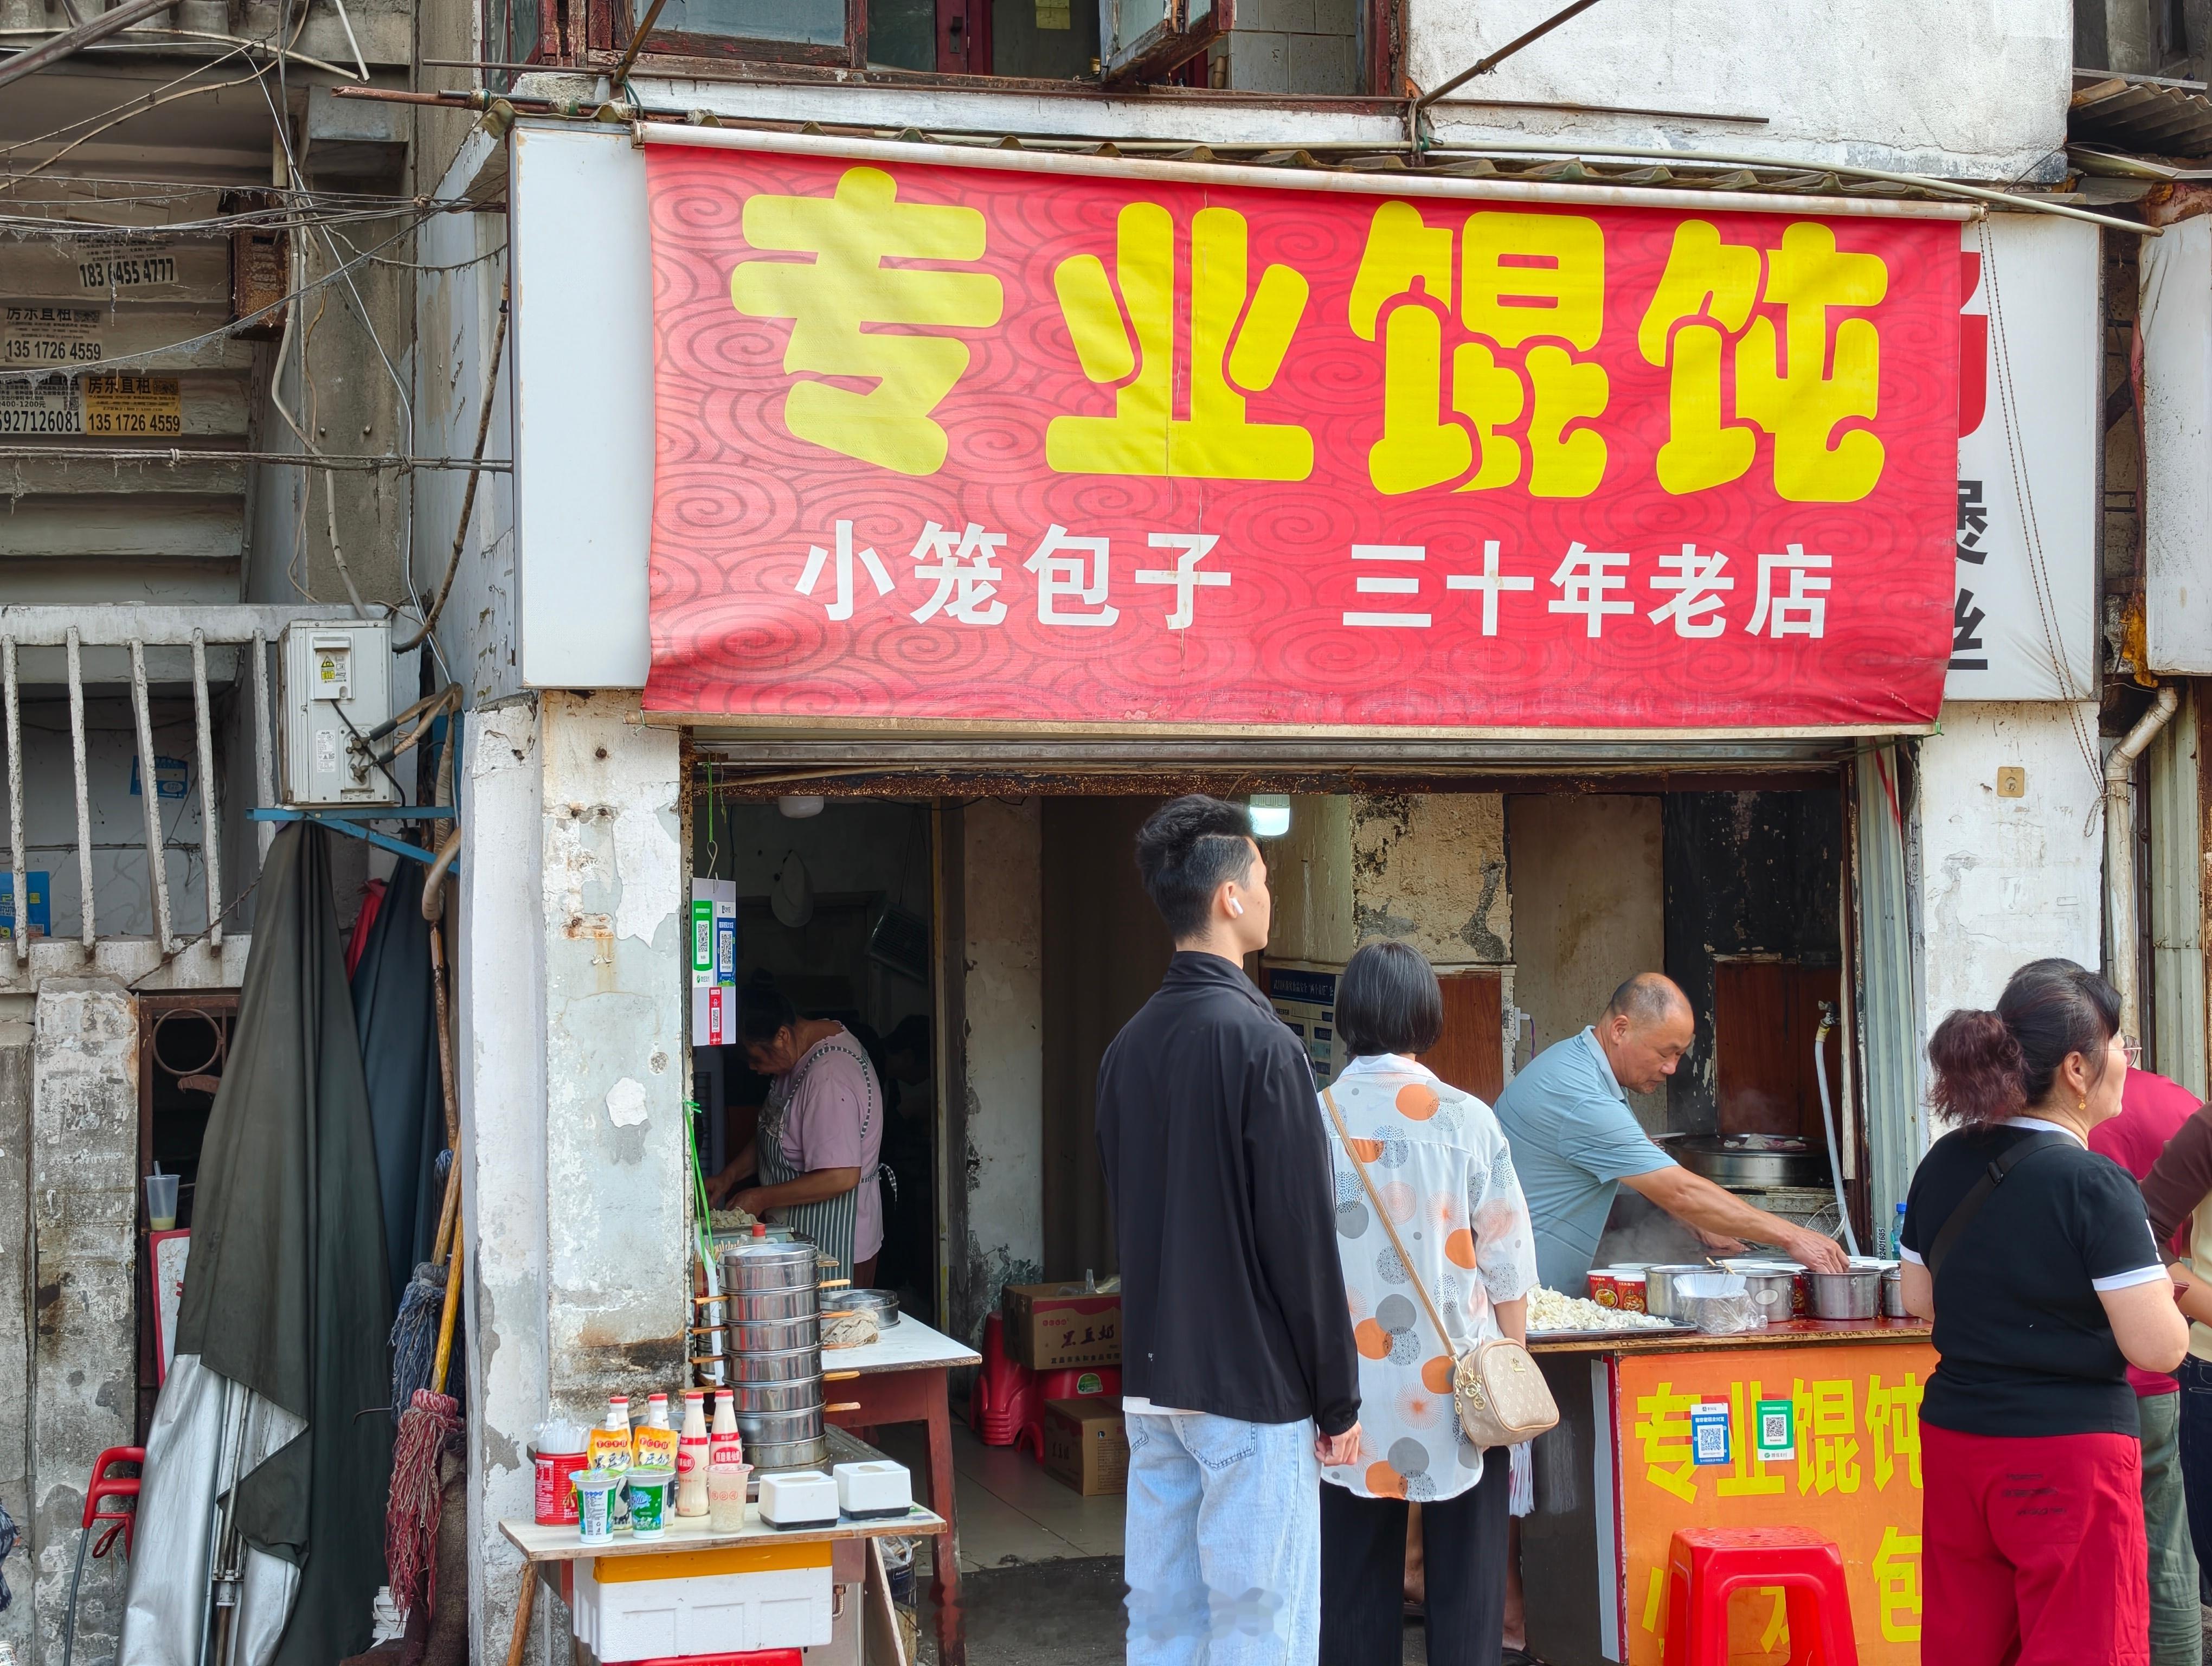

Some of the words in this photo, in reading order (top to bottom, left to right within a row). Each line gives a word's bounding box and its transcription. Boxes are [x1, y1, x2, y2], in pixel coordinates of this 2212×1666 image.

[80, 263, 104, 287] 183
[144, 258, 173, 283] 4777
[731, 166, 1888, 503] 专业馄饨
[7, 340, 30, 358] 135
[35, 341, 66, 359] 1726
[70, 342, 101, 360] 4559
[0, 410, 81, 432] 927126081
[89, 413, 111, 431] 135
[116, 414, 145, 431] 1726
[150, 414, 180, 432] 4559
[794, 519, 1232, 630] 小笼包子
[1342, 540, 1832, 638] 三十年老店
[1635, 1373, 1924, 1503] 专业馄饨
